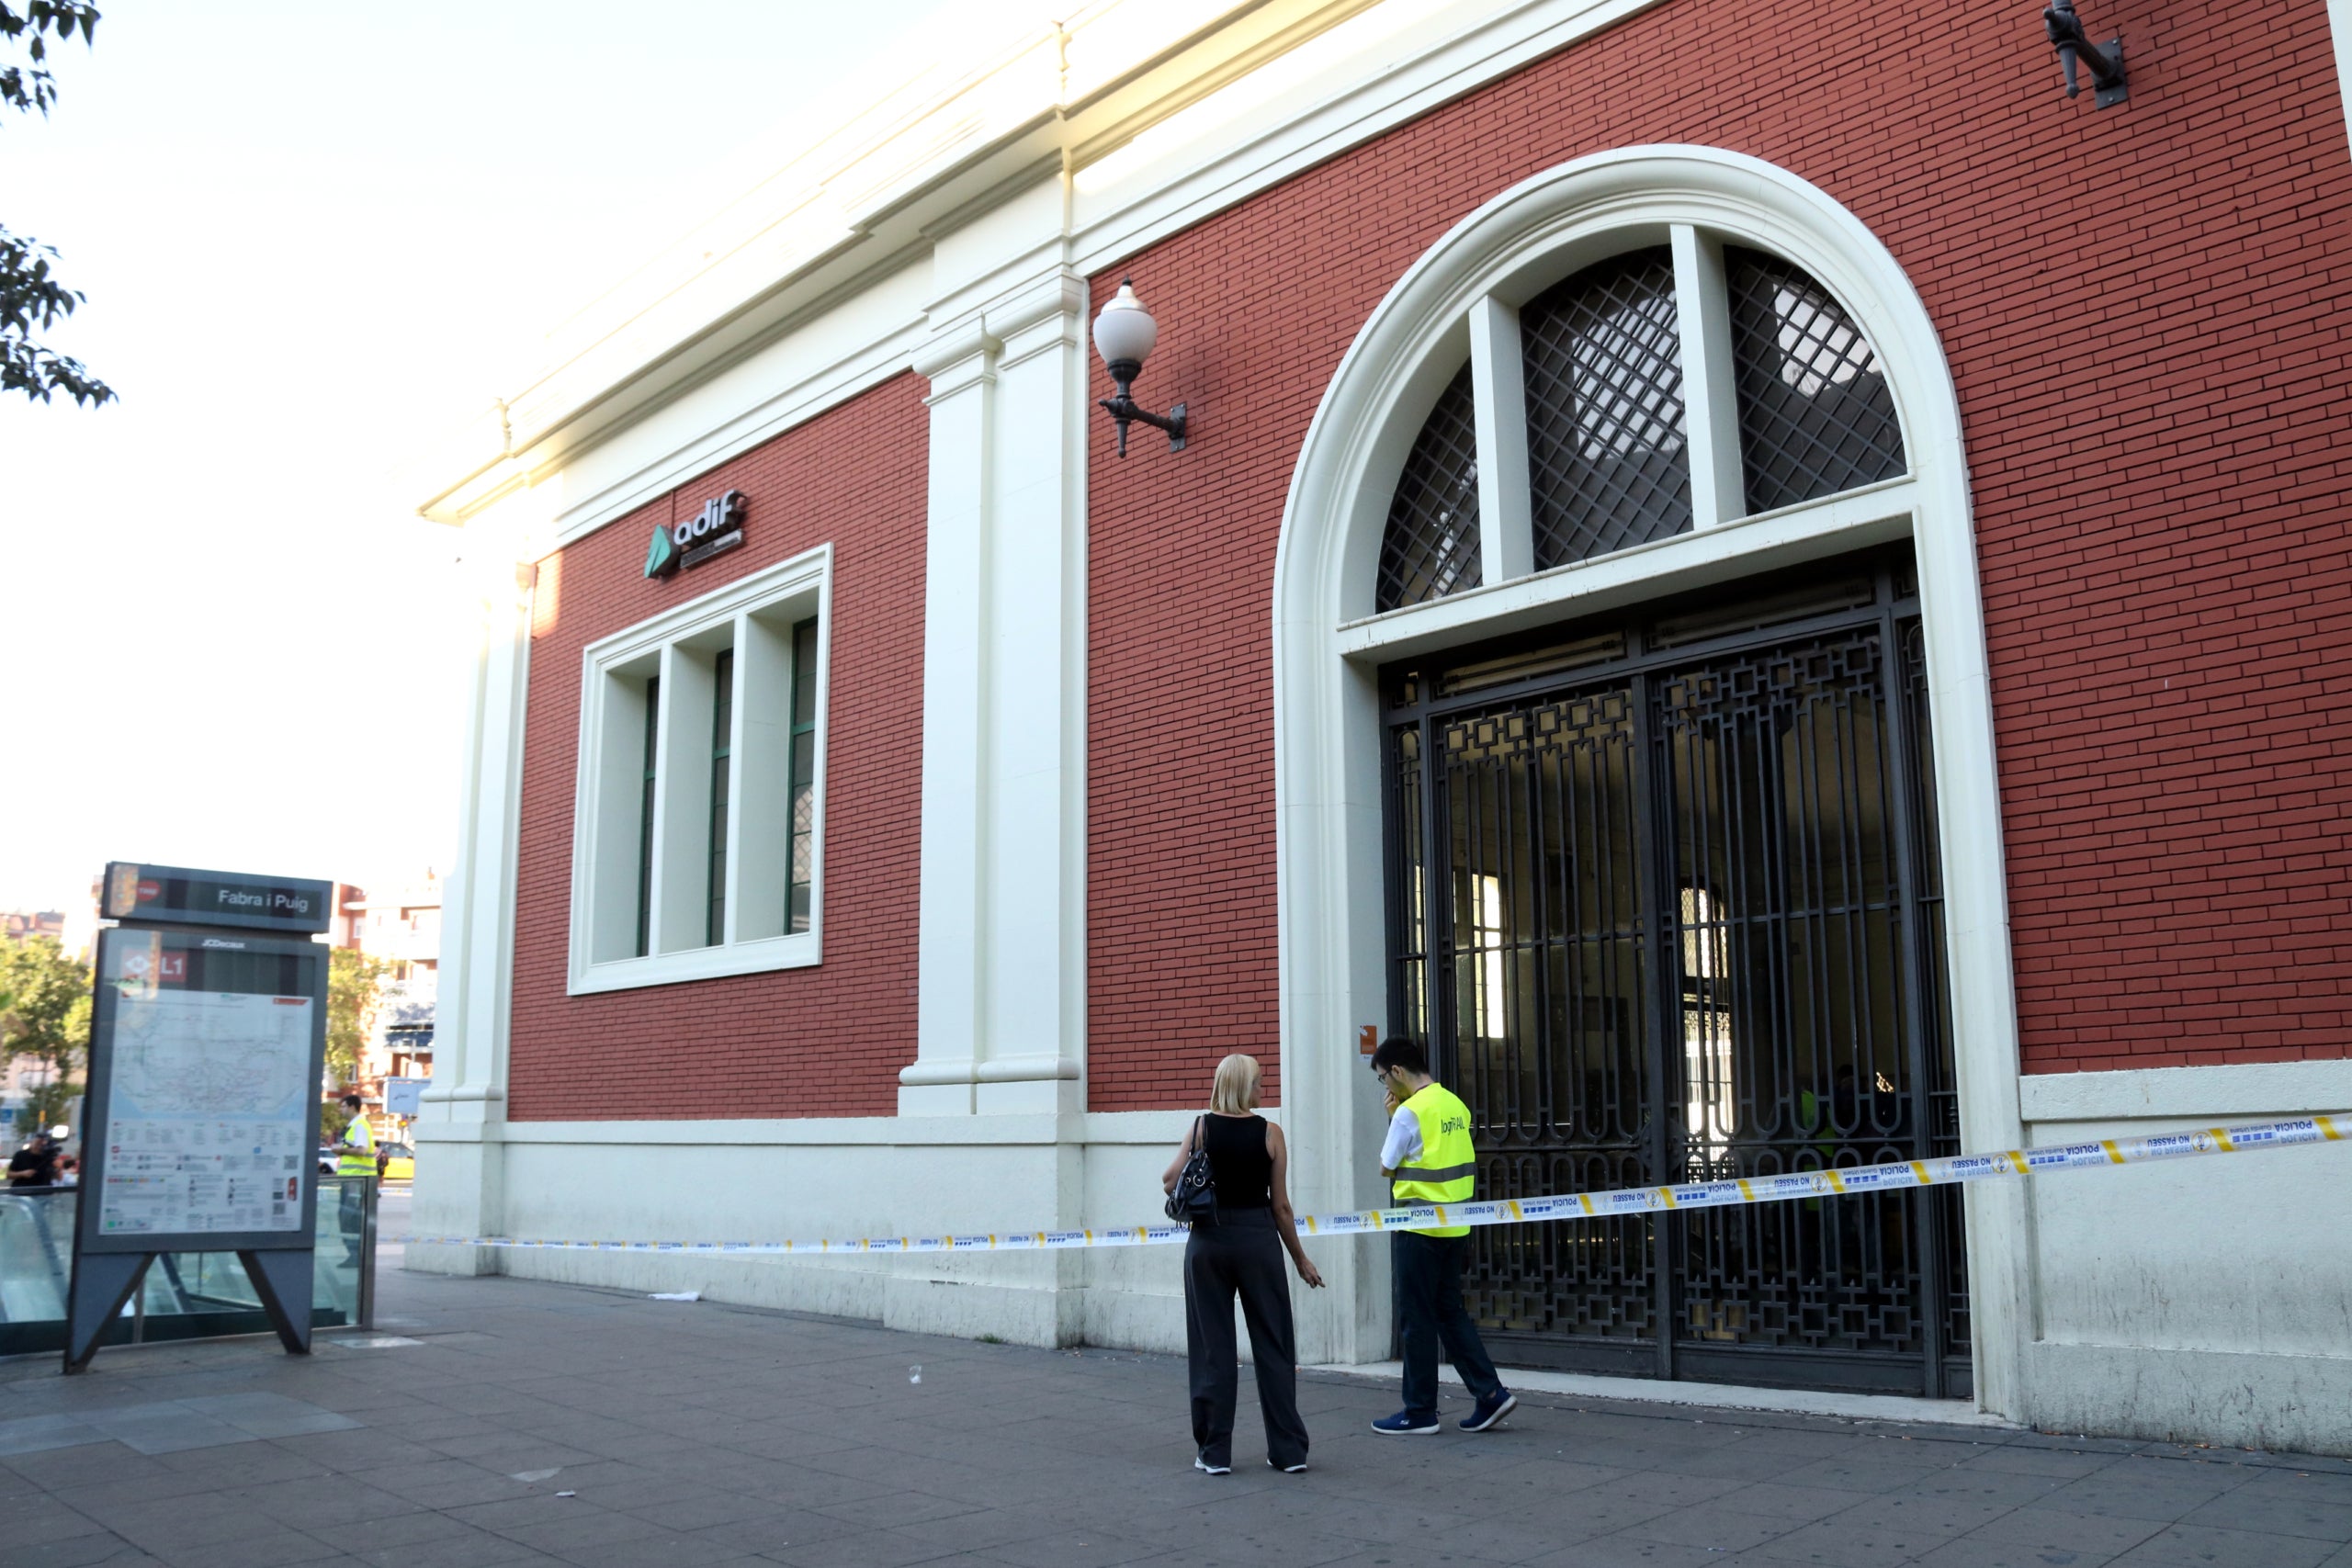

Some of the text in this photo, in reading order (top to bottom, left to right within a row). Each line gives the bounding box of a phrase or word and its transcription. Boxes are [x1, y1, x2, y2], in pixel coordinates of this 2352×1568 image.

[673, 489, 735, 545] adif
[219, 890, 309, 912] Fabra i Puig
[201, 939, 245, 949] JCDecaux
[161, 957, 182, 975] L1
[2274, 1120, 2312, 1133] POLICIA
[2147, 1134, 2190, 1147] NO PASSEU
[2067, 1144, 2099, 1156] POLICIA
[1952, 1157, 1991, 1168] NO PASSEU
[1880, 1166, 1909, 1175] POLICIA
[1708, 1182, 1736, 1192] POLICIA
[1774, 1178, 1798, 1188] PASSEU
[1553, 1198, 1577, 1206] POLICIA
[1612, 1192, 1645, 1202] NO PASSEU
[1410, 1209, 1434, 1217] POLICIA
[1464, 1205, 1495, 1214] NO PASSEU
